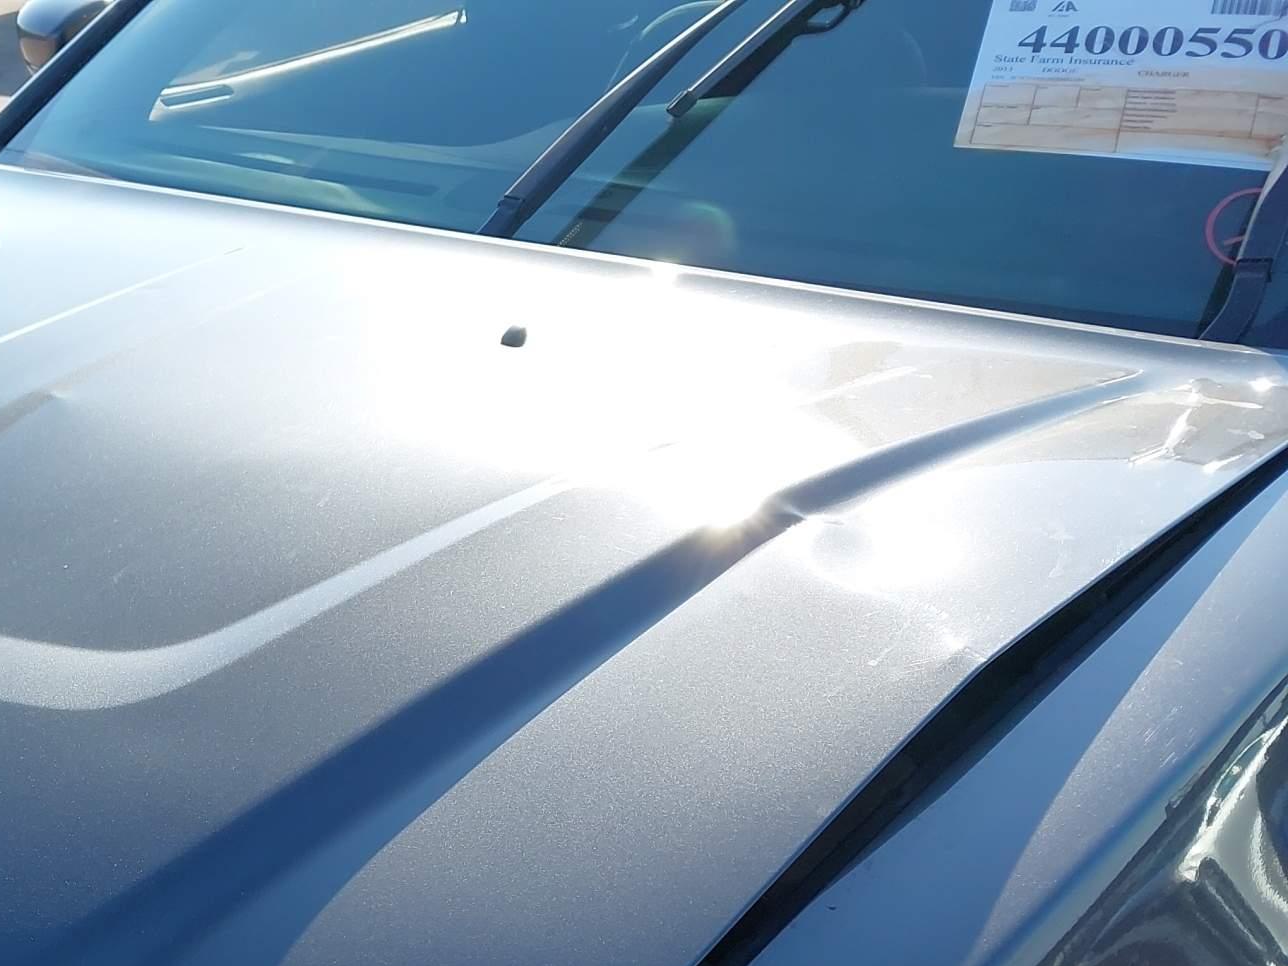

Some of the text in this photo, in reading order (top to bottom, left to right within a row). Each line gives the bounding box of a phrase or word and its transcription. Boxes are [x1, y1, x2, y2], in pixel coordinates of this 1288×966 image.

[1018, 24, 1288, 61] 44000550
[993, 54, 1135, 66] State Farm Insurance
